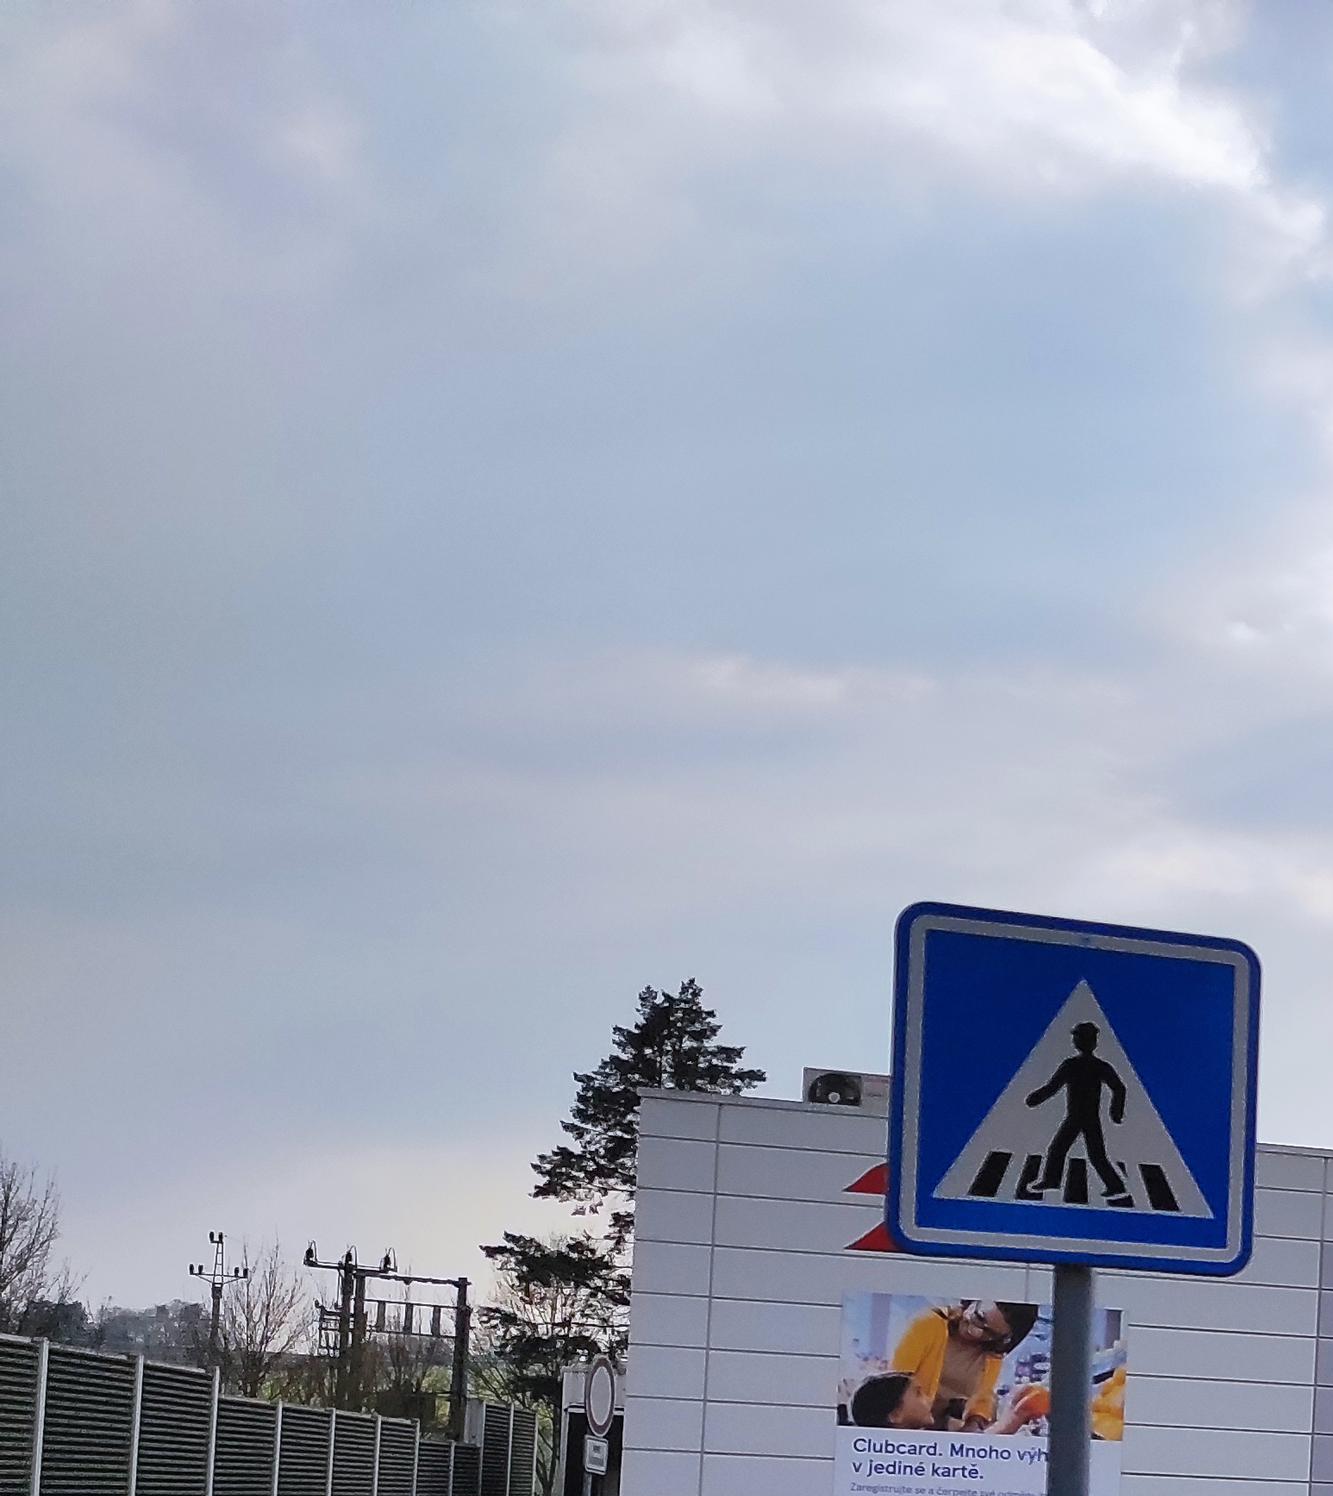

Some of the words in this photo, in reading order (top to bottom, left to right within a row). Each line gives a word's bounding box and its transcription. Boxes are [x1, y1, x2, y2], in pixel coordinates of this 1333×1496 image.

[852, 1437, 944, 1457] Clubcard.
[950, 1442, 1012, 1460] Mnoho
[1017, 1446, 1049, 1465] výh
[851, 1461, 863, 1473] v
[867, 1459, 925, 1478] jediné
[931, 1463, 984, 1480] kartě.
